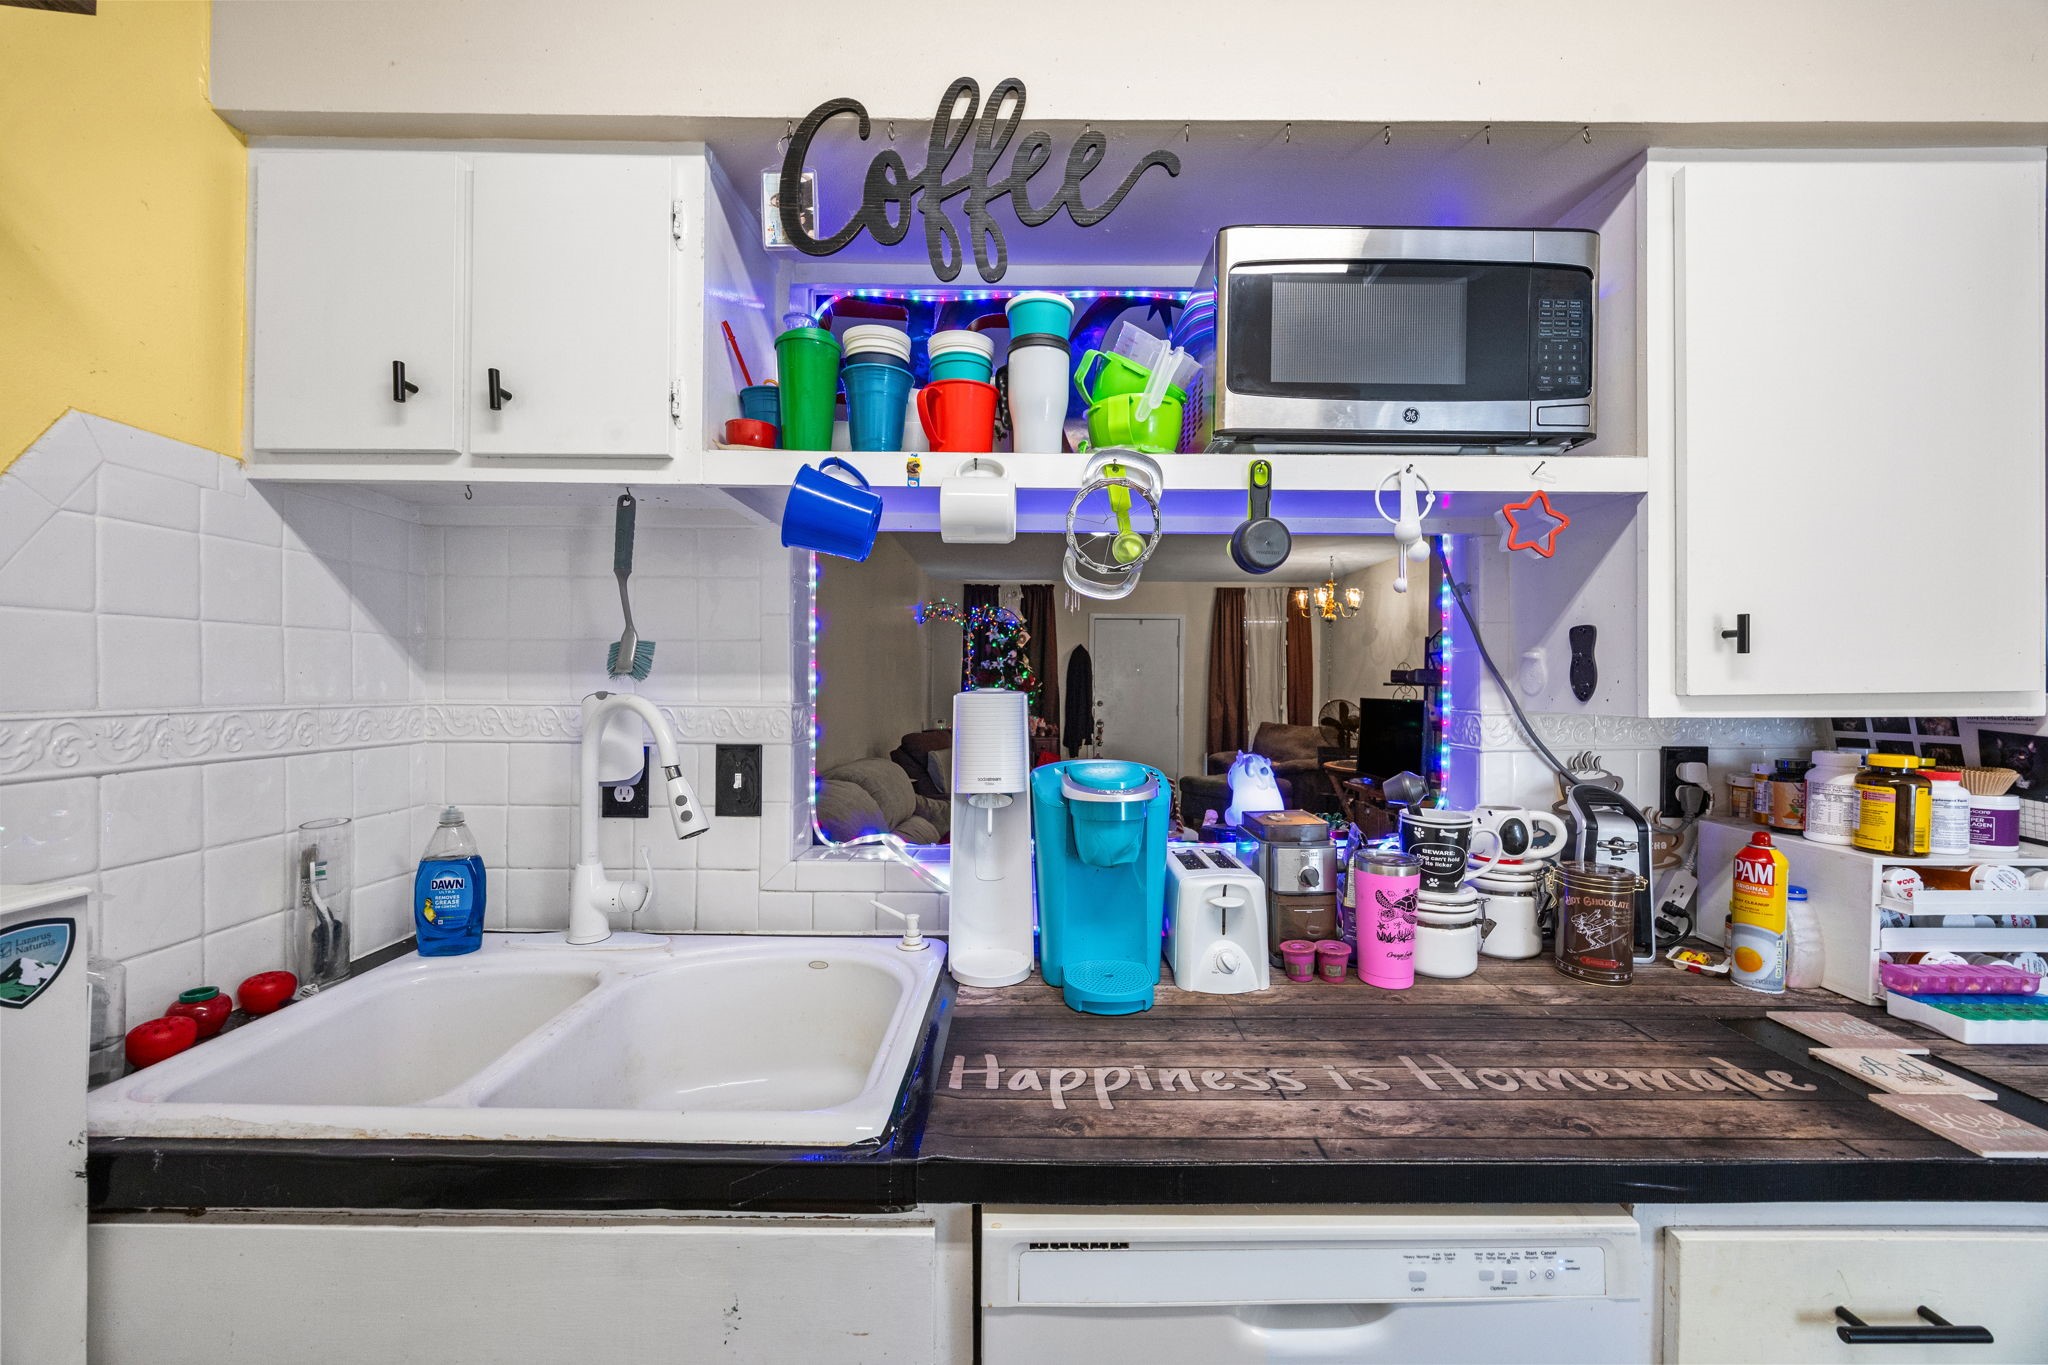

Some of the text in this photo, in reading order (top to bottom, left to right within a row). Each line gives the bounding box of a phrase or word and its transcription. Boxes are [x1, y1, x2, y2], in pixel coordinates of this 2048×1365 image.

[779, 76, 1182, 283] Coffee
[1416, 853, 1429, 861] Dog
[1422, 848, 1455, 856] BEWARE:
[1734, 858, 1773, 886] PAM
[431, 878, 464, 890] DAWN
[1735, 882, 1769, 893] ORIGINAL
[1903, 877, 1915, 885] CVS
[1565, 895, 1630, 909] HOT CHOCOLATE
[15, 932, 52, 947] Lazarus
[15, 938, 56, 955] Naturals
[948, 1053, 1818, 1110] Happiness is Homemade
